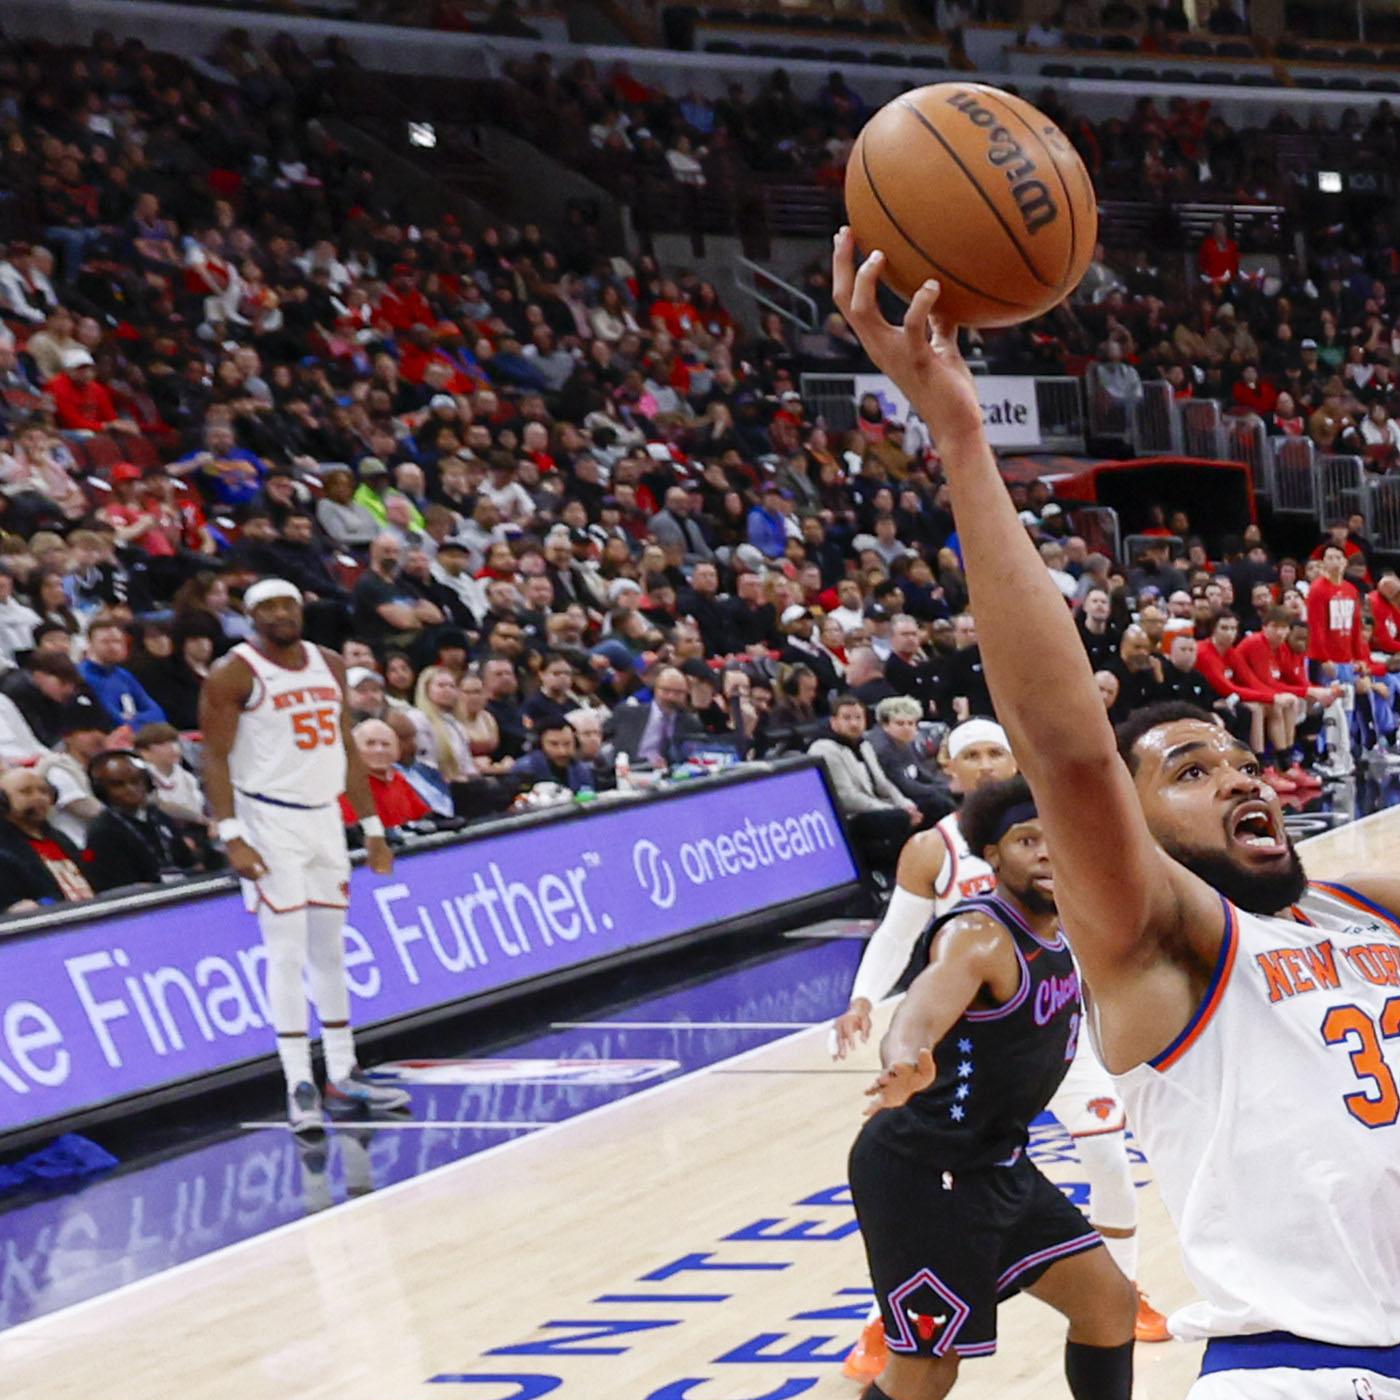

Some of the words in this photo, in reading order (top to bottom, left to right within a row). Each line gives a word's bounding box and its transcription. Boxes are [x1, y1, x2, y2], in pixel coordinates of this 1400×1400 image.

[947, 91, 1057, 236] Wilson
[292, 709, 336, 751] 55
[679, 808, 835, 884] onestream
[64, 925, 382, 1069] Finane
[1255, 938, 1342, 1003] NEW
